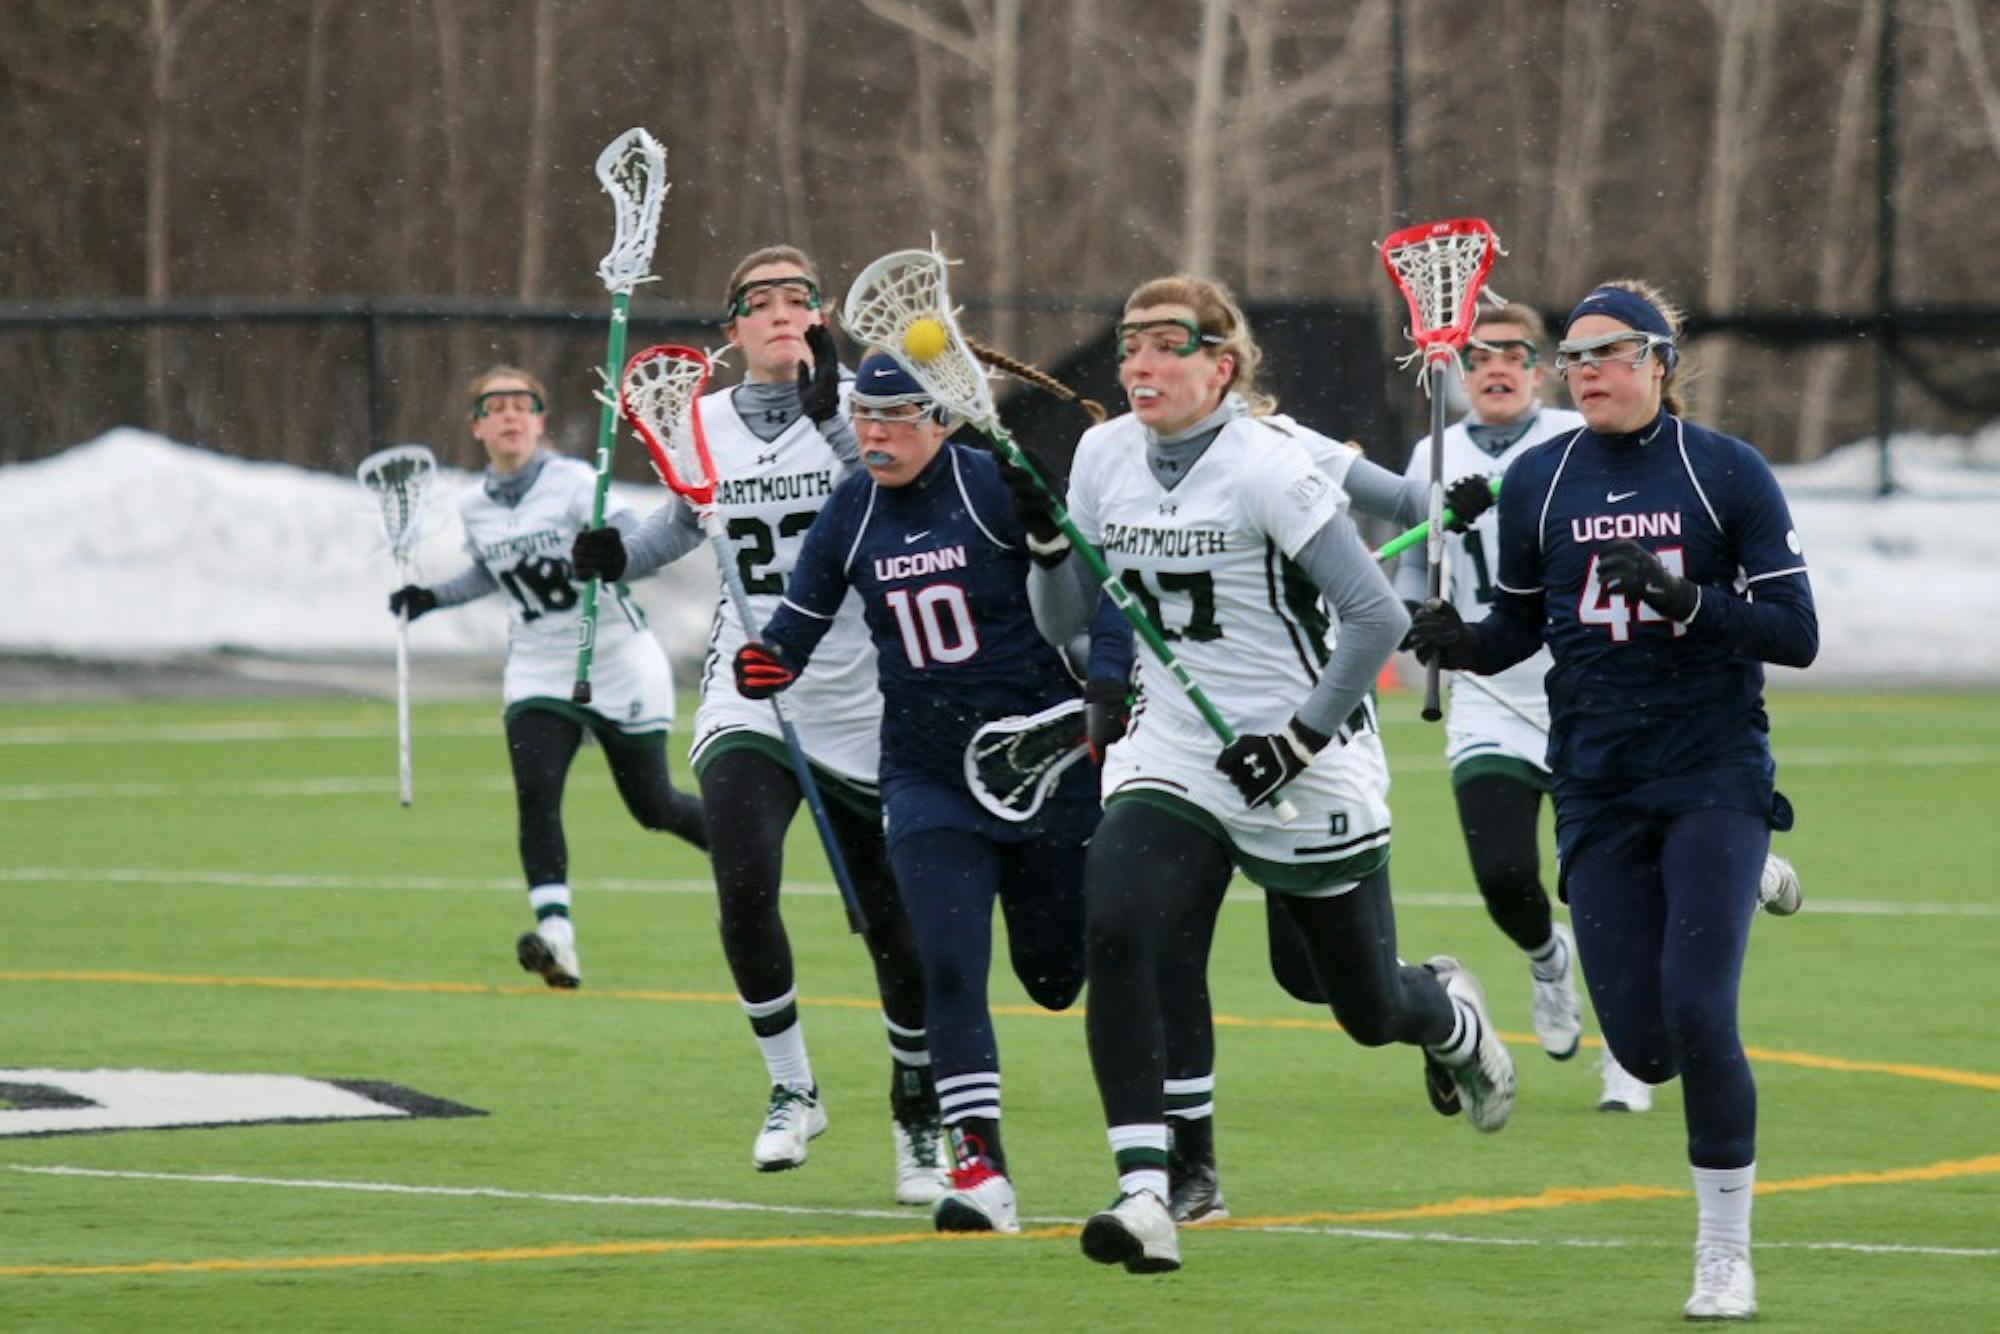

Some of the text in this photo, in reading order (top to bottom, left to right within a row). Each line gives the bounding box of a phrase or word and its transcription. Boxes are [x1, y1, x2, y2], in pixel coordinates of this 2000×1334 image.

[1104, 523, 1226, 557] DARTMOUTH
[1571, 511, 1681, 543] UCONN
[874, 545, 967, 582] UCONN
[500, 551, 579, 624] 18
[1120, 568, 1224, 643] 17
[884, 582, 981, 670] 10
[1330, 813, 1348, 836] D
